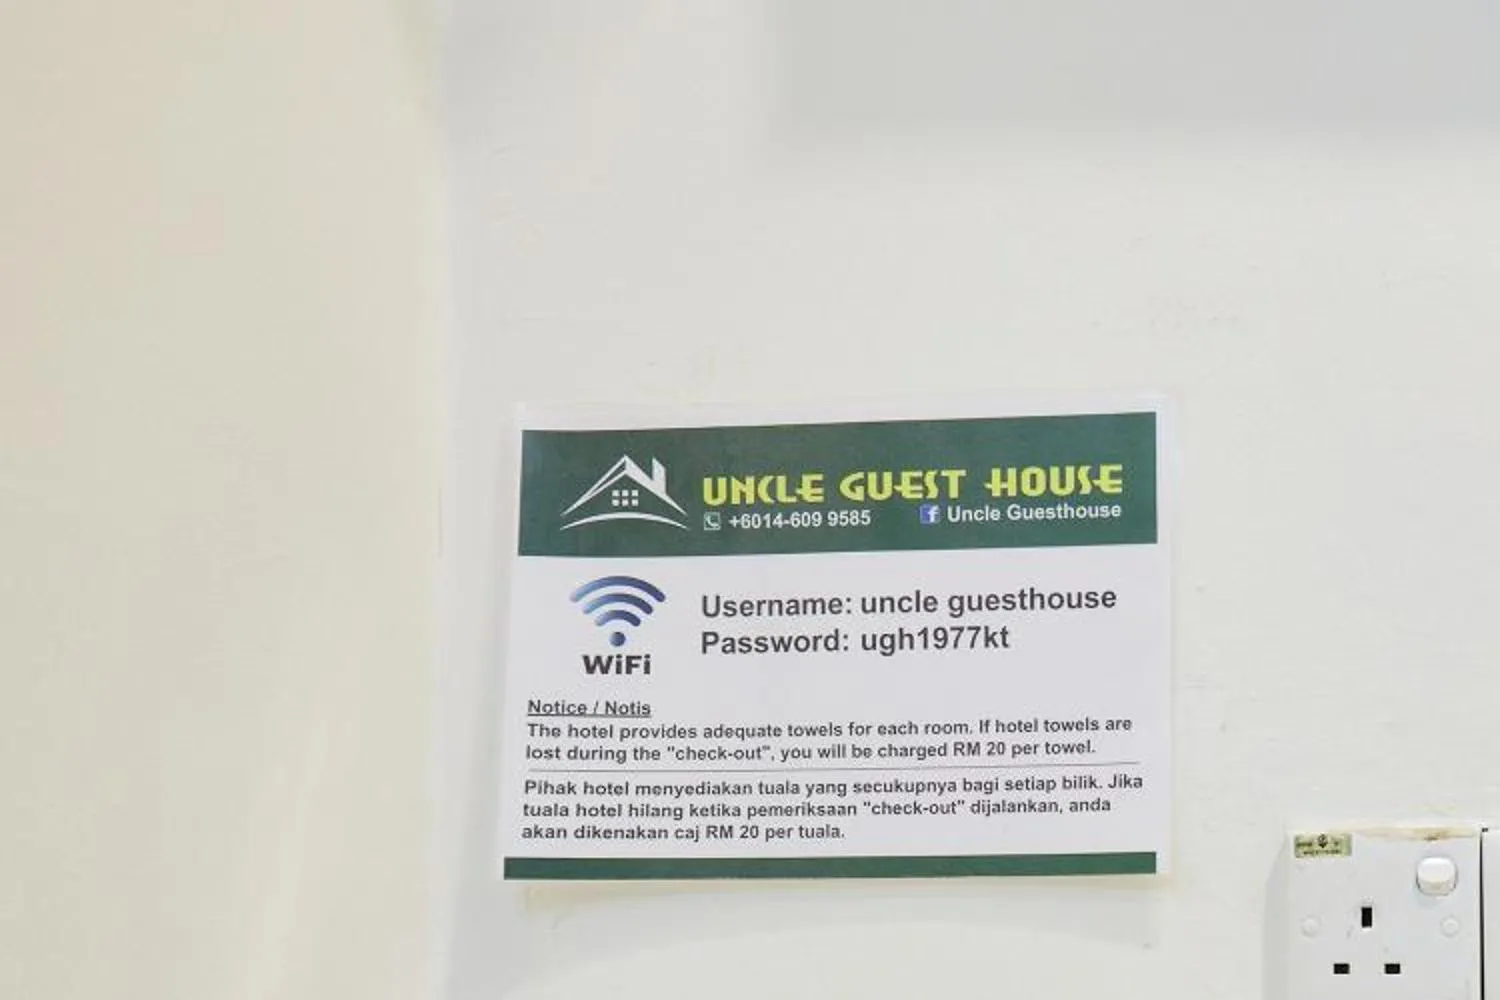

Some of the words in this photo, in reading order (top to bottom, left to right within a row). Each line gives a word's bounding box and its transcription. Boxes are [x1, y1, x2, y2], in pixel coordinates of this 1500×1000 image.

[703, 475, 824, 506] UNCLE
[840, 469, 966, 500] GUEST
[985, 464, 1123, 497] HOUSE
[729, 511, 822, 529] +6014-609
[827, 509, 871, 527] 9585
[947, 505, 1001, 522] Uncle
[1006, 502, 1122, 521] Guesthouse
[702, 594, 852, 618] Username:
[861, 589, 939, 614] uncle
[947, 586, 1117, 619] guesthouse
[701, 628, 849, 654] Password:
[861, 625, 1009, 657] ugh1977kt
[582, 653, 651, 675] WiFi
[527, 699, 588, 716] Notice
[604, 701, 651, 717] Notis
[527, 723, 561, 738] The
[567, 723, 614, 738] hotel
[619, 724, 698, 742] provides
[703, 724, 783, 741] adequate
[787, 722, 843, 738] towels
[848, 721, 873, 737] for
[877, 721, 919, 736] each
[924, 722, 973, 735] room.
[979, 719, 991, 734] If
[995, 718, 1039, 733] hotel
[1043, 717, 1100, 732] towels
[1105, 718, 1132, 731] are
[526, 745, 561, 760] lost
[566, 745, 627, 764] during
[633, 746, 661, 760] the
[780, 747, 812, 763] you
[817, 744, 847, 759] will
[851, 744, 873, 759] be
[877, 742, 948, 760] charged
[953, 741, 981, 757] RM
[986, 741, 1006, 757] 20
[1011, 743, 1039, 758] per
[1044, 739, 1096, 755] towel.
[524, 779, 577, 796] Pihak
[583, 781, 630, 796] hotel
[635, 781, 753, 799] menyediakan
[758, 780, 800, 795] tuala
[805, 783, 847, 799] yang
[853, 779, 957, 797] secukupnya
[962, 777, 999, 795] bagi
[1004, 776, 1057, 794] setiap
[1061, 775, 1103, 790] bilik.
[1107, 774, 1143, 790] Jika
[523, 803, 569, 817] tuala
[575, 803, 623, 818] hotel
[628, 803, 684, 821] hilang
[689, 803, 741, 817] ketika
[747, 801, 857, 820] pemeriksaan
[863, 800, 965, 815] "check-out"
[970, 799, 1063, 817] dijalankan,
[1069, 797, 1111, 813] anda
[521, 824, 568, 839] akan
[573, 824, 669, 840] dikenakan
[674, 825, 700, 843] caj
[705, 824, 734, 839] RM
[739, 824, 759, 839] 20
[765, 825, 794, 842] per
[798, 823, 845, 839] tuala.
